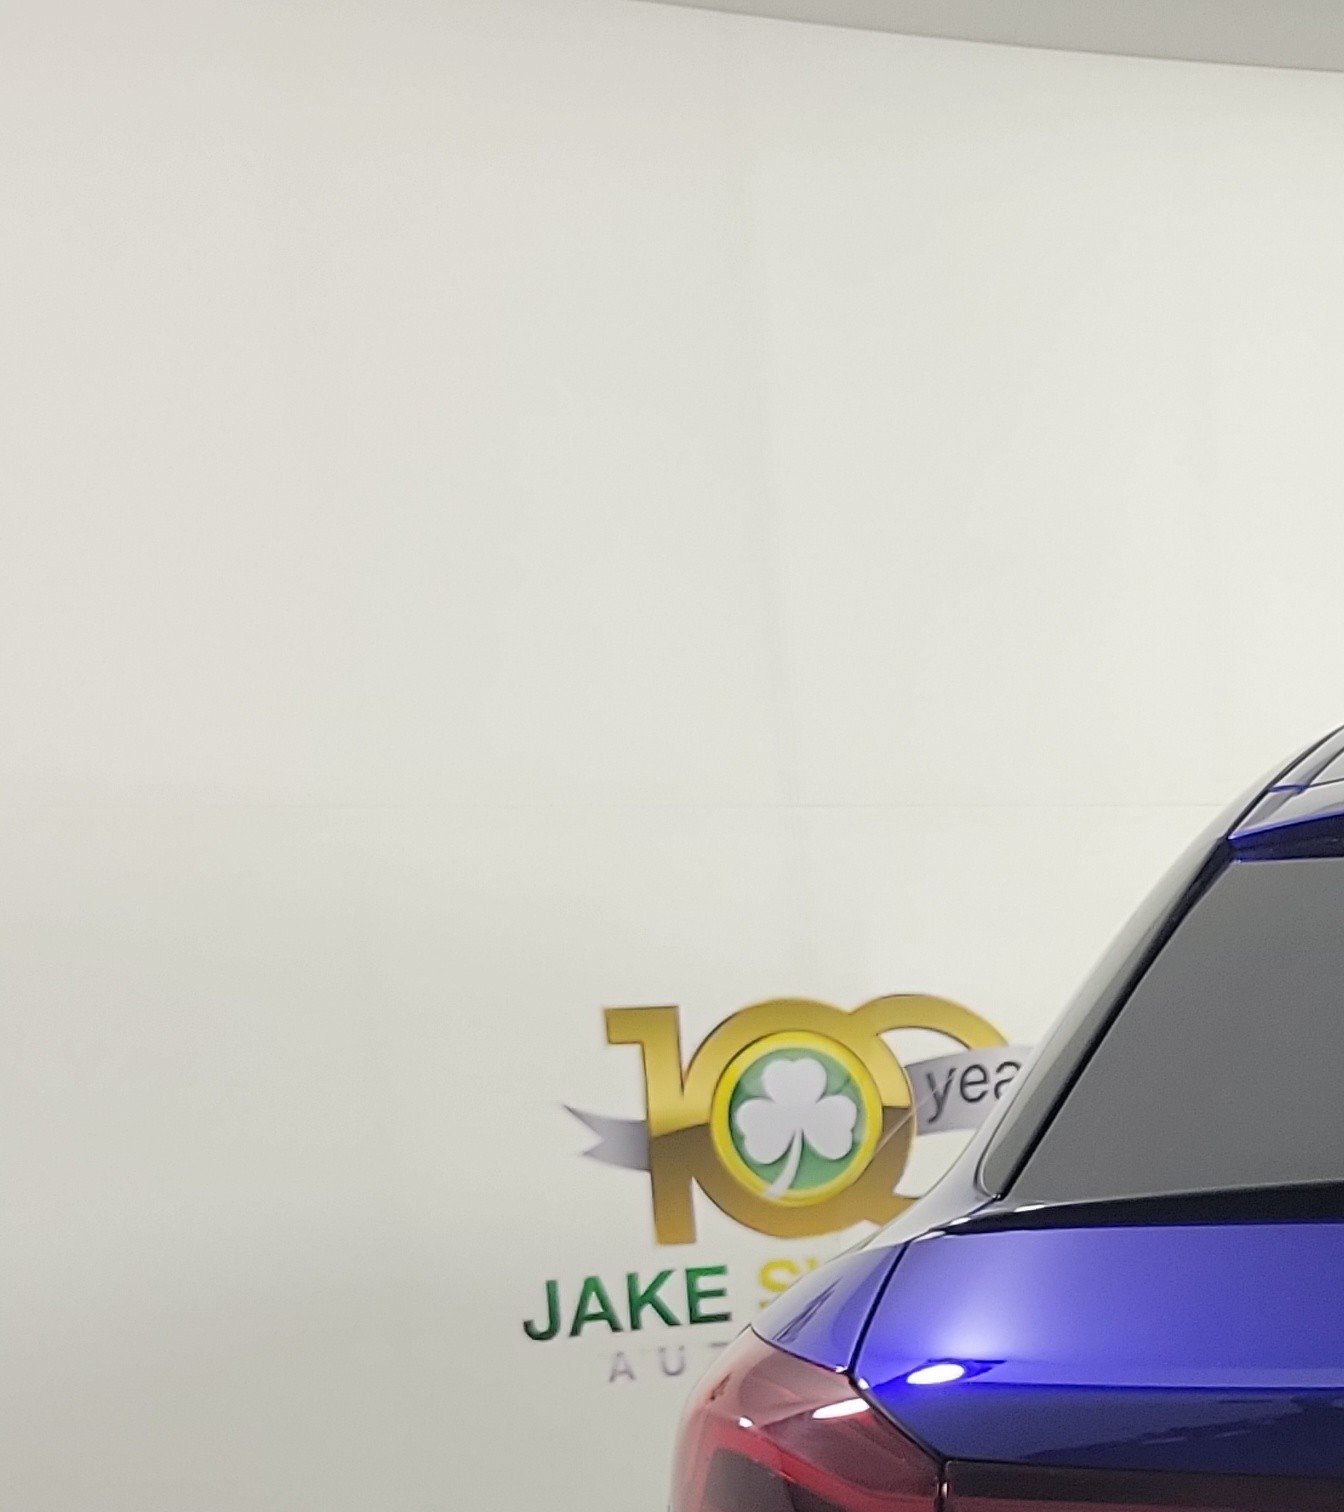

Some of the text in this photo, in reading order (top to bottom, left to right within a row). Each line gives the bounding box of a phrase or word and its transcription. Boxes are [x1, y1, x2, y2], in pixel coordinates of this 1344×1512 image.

[604, 994, 1009, 1245] 100
[926, 1061, 1022, 1124] yea
[523, 1265, 732, 1341] JAKE
